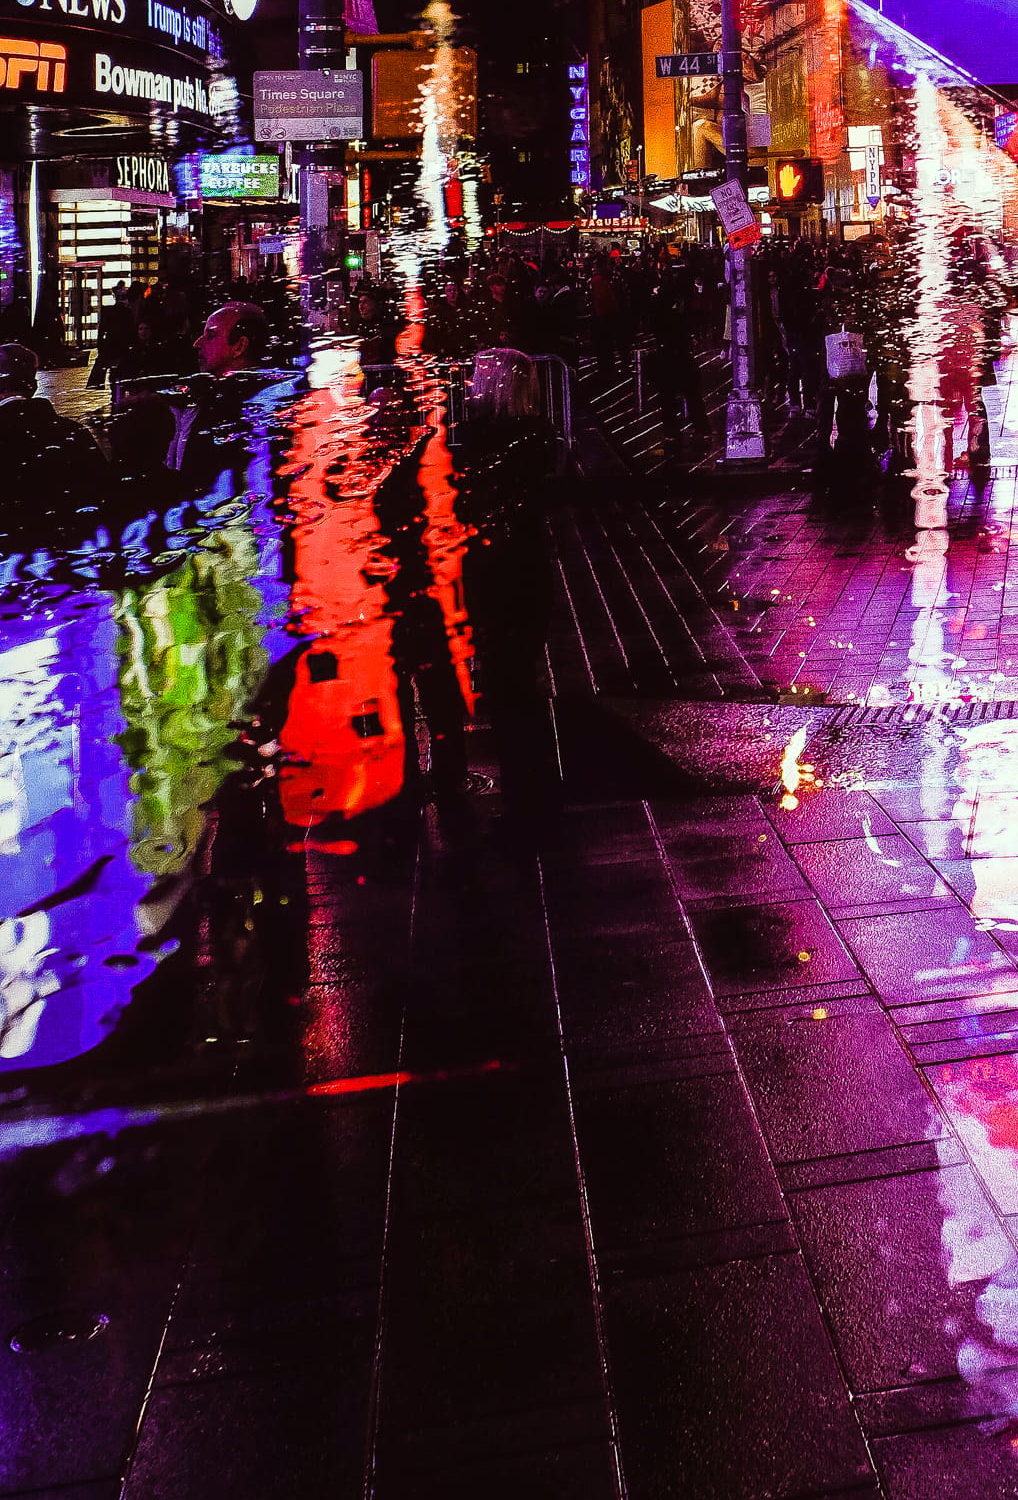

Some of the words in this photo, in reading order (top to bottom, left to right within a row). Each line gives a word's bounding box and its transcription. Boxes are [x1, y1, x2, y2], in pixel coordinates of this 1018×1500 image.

[183, 6, 191, 43] is
[192, 15, 206, 51] still
[659, 58, 672, 76] W
[678, 56, 700, 74] 44
[706, 55, 716, 65] ST
[95, 53, 172, 103] Bowman
[173, 76, 195, 114] puts
[195, 78, 209, 115] No.
[259, 89, 298, 100] Times
[300, 88, 345, 101] Square
[260, 103, 324, 114] Pedestrian
[325, 102, 357, 113] Plaza
[116, 155, 169, 192] SEPHORA
[868, 147, 877, 196] NYPD
[208, 178, 261, 189] COFFEE
[720, 187, 733, 199] NO
